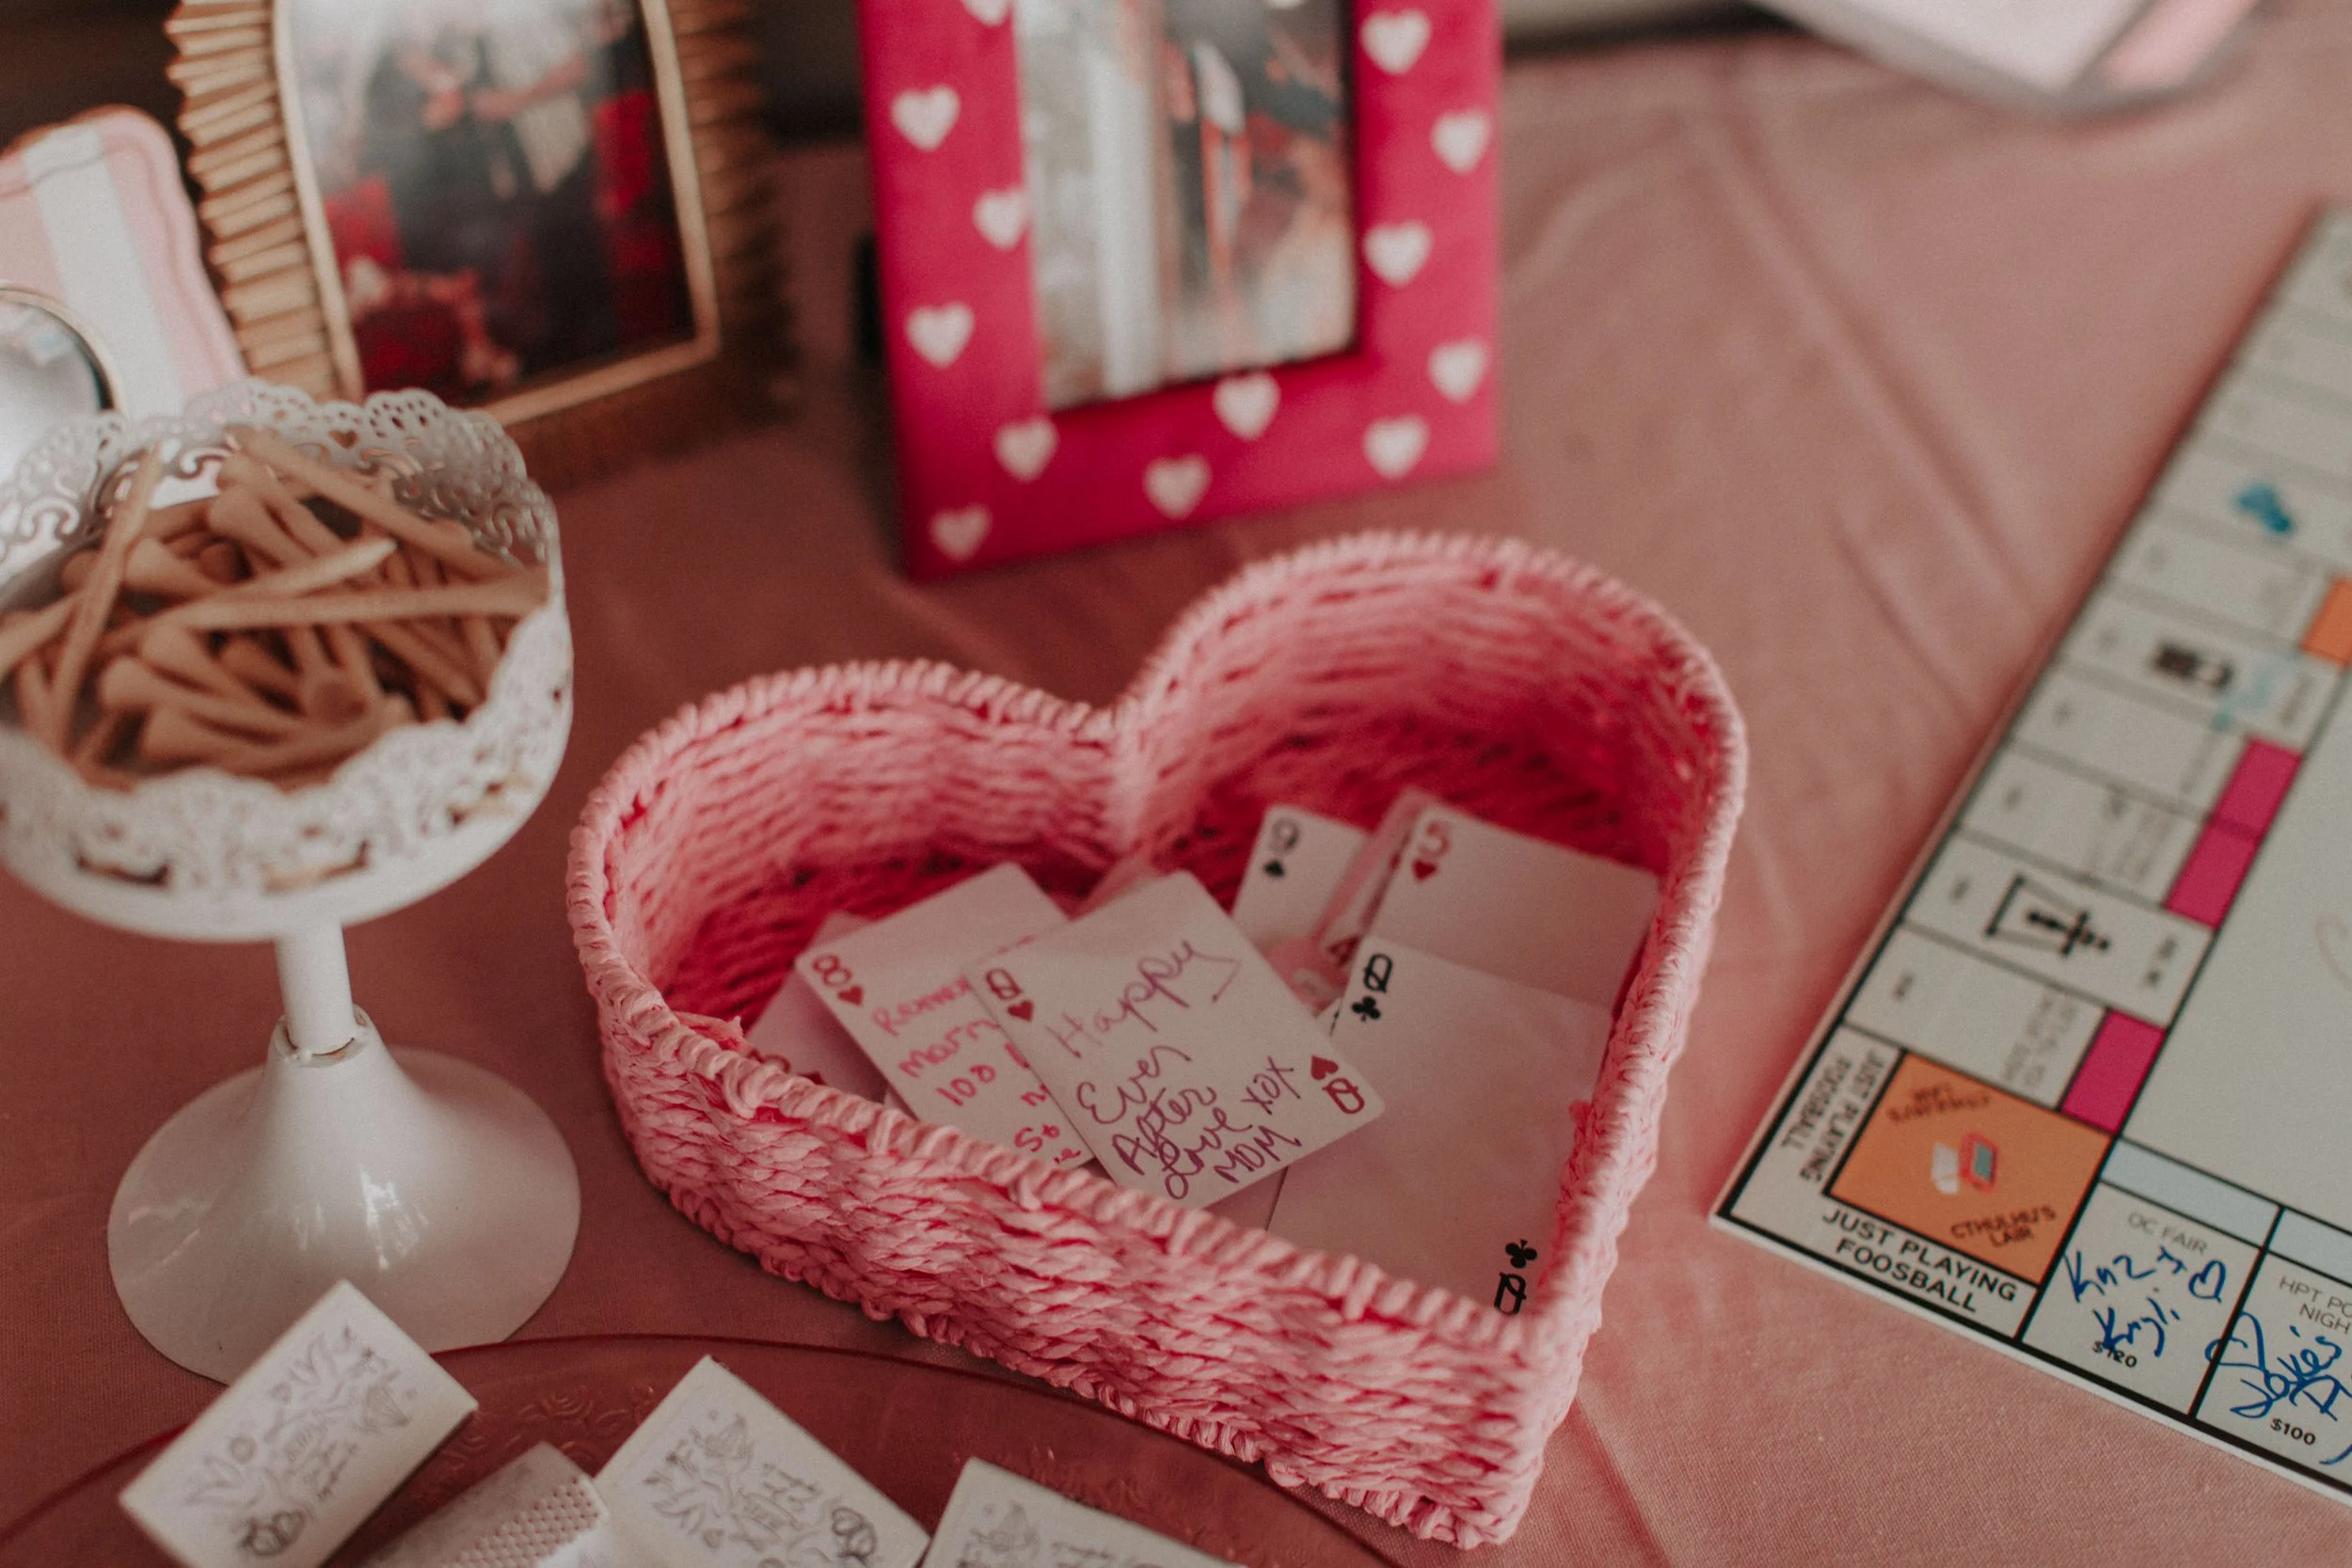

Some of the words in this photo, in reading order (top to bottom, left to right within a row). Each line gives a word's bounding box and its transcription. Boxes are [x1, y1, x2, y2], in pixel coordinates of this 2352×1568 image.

[812, 954, 852, 988] 8
[985, 967, 1024, 1001] Q
[1364, 953, 1393, 994] Q
[1044, 941, 1241, 1059] Happy
[1076, 1045, 1193, 1125] Ever
[1322, 1077, 1365, 1115] Q
[1112, 1086, 1217, 1176] After
[1158, 1106, 1253, 1200] Love
[1822, 1209, 1895, 1246] JUST
[1899, 1238, 2018, 1303] PLAYING
[2127, 1211, 2158, 1235] OC
[2161, 1226, 2210, 1256] FAIR
[1493, 1272, 1528, 1317] Q
[1836, 1237, 1977, 1313] FOOSBALL
[2279, 1275, 2324, 1304] HPT
[2269, 1417, 2317, 1446] $100
